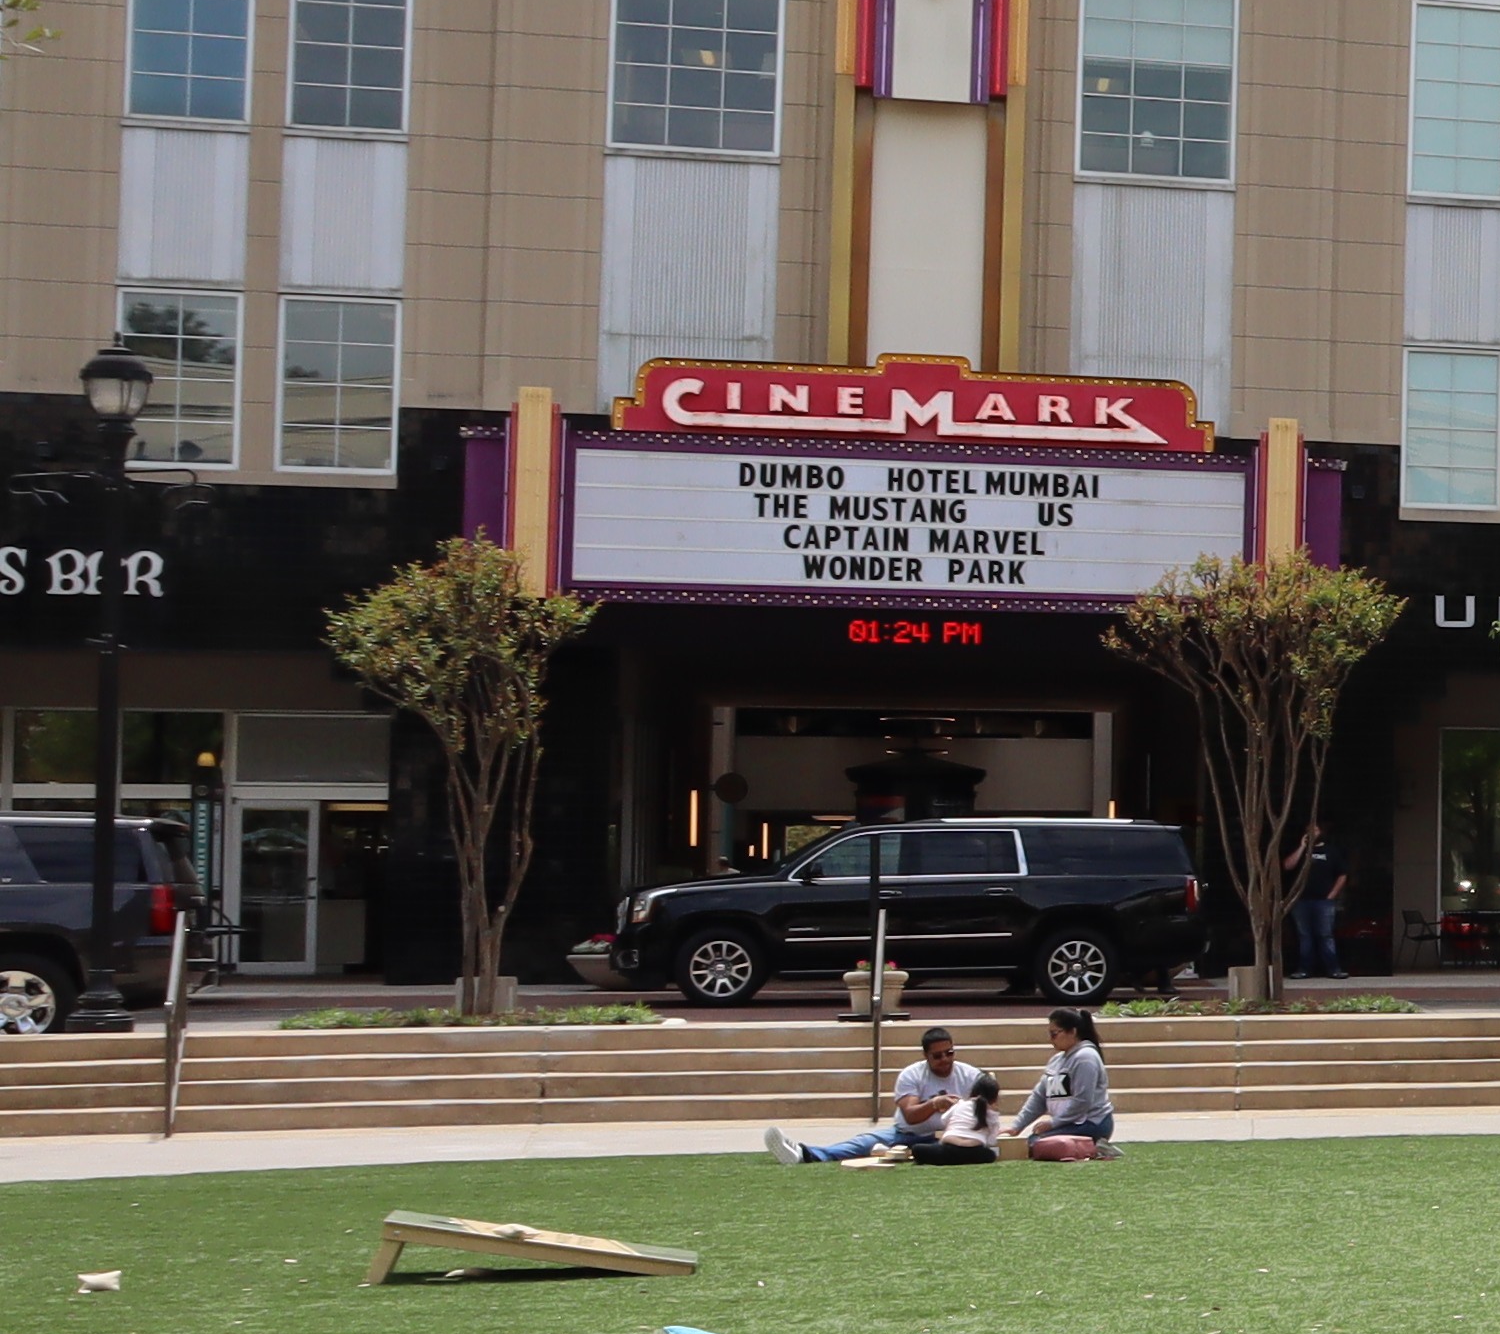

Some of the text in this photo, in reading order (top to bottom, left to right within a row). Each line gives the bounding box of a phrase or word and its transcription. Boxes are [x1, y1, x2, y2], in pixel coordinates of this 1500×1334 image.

[662, 377, 1169, 445] CINEMARK
[739, 462, 1100, 499] DUMBO HOTEL MUMBAI
[754, 493, 1074, 527] THE MUSTANG US
[783, 524, 1045, 556] CAPTAIN MARVEL
[803, 554, 1026, 585] WONDER PARK
[849, 620, 982, 645] 01:24 PM
